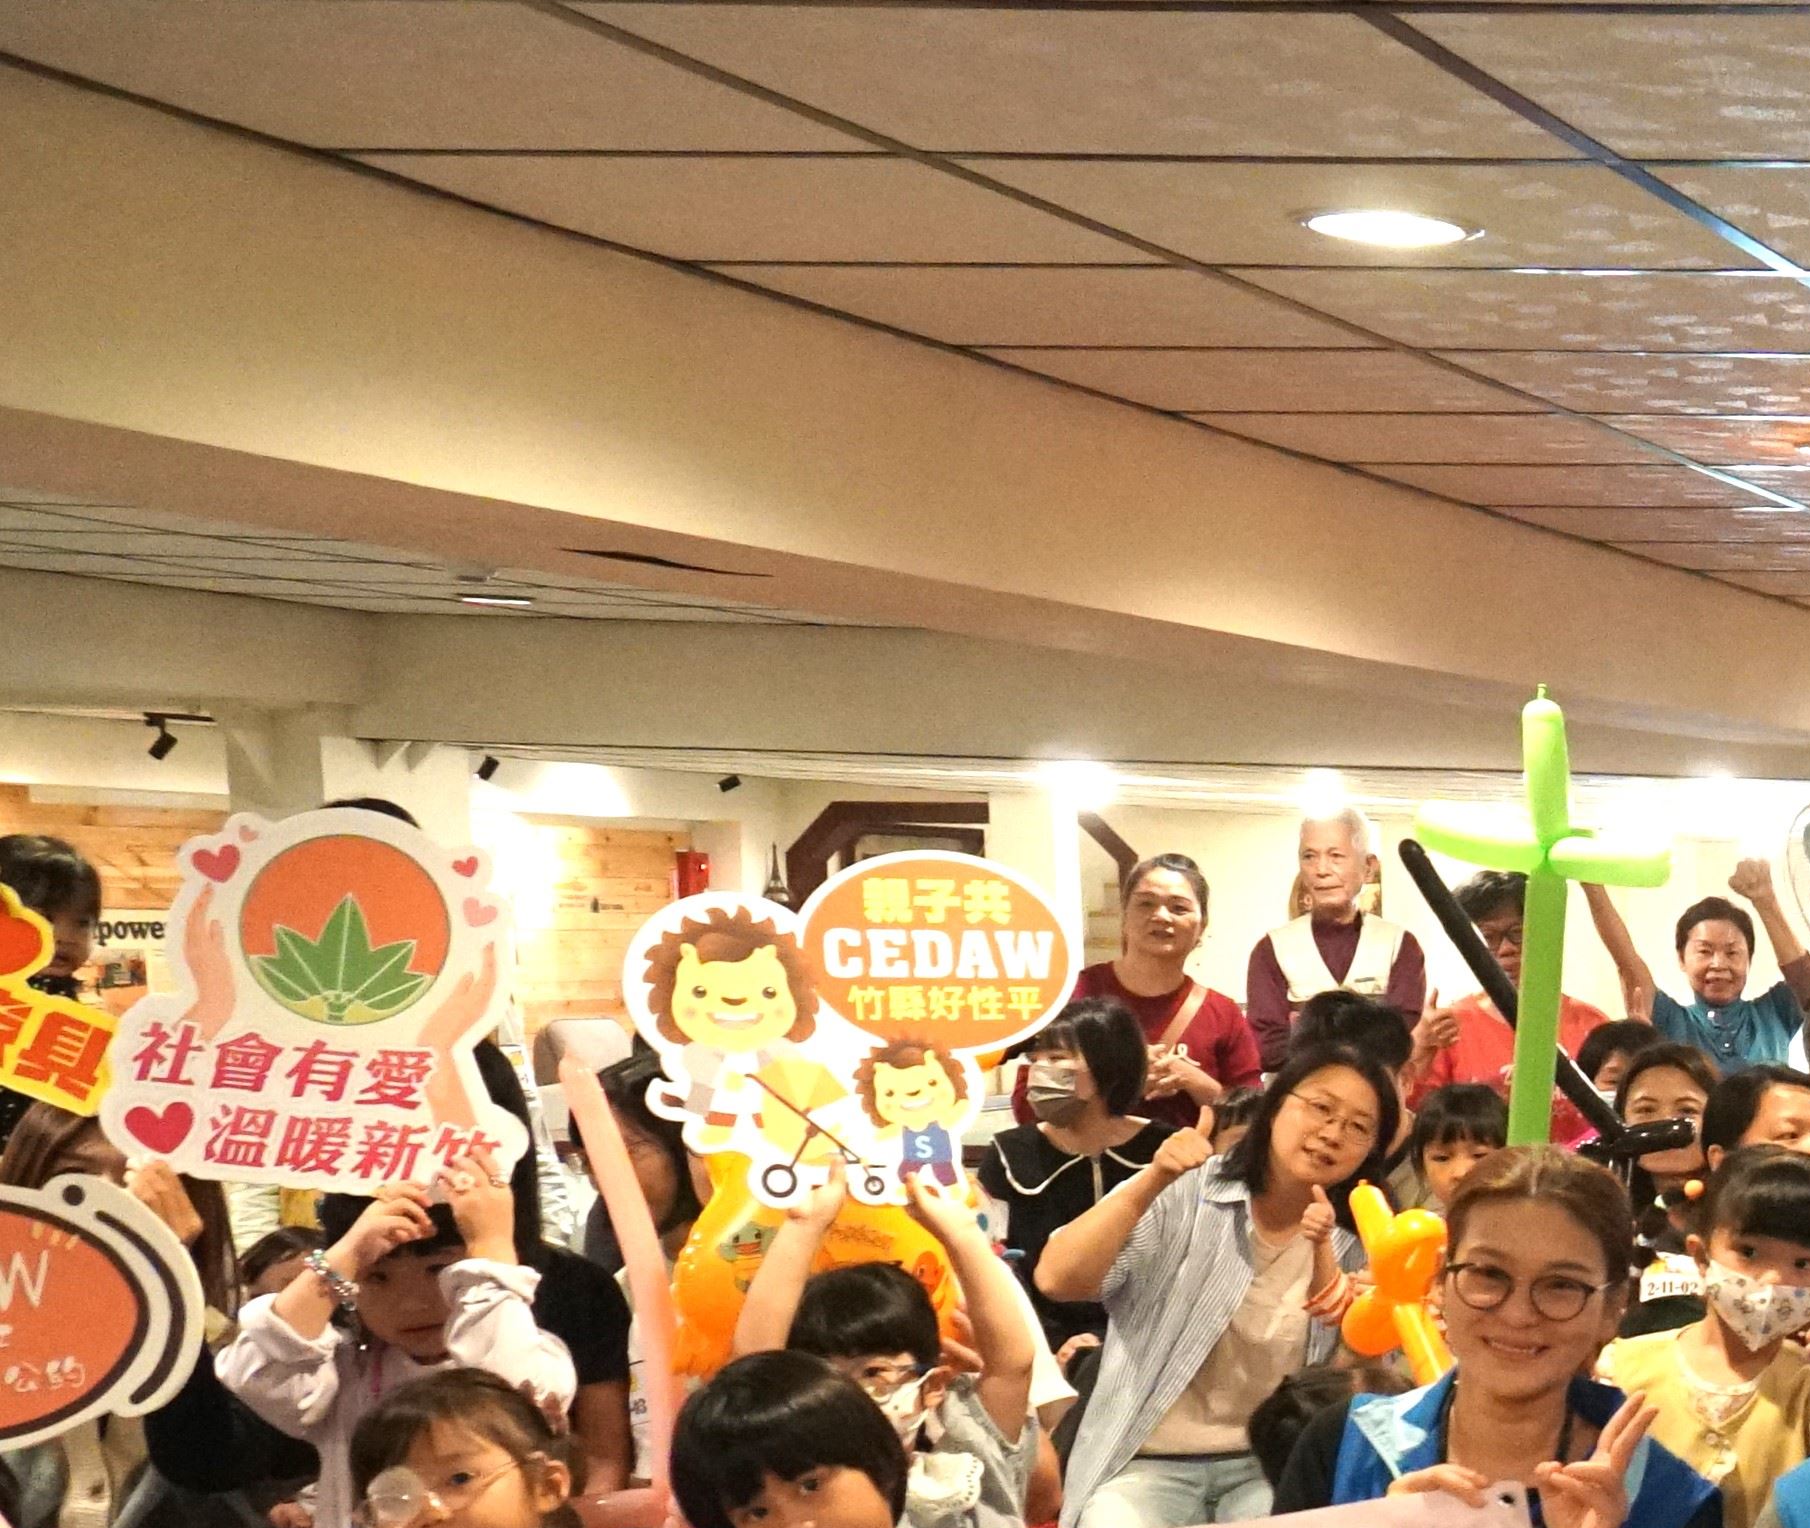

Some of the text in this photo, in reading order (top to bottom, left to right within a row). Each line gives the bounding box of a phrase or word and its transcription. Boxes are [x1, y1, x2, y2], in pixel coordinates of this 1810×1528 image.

[862, 877, 1013, 925] 親子共
[96, 919, 166, 946] powe
[823, 927, 1054, 979] CEDAW
[848, 984, 1044, 1021] 竹縣好性平
[132, 1021, 433, 1110] 社會有愛
